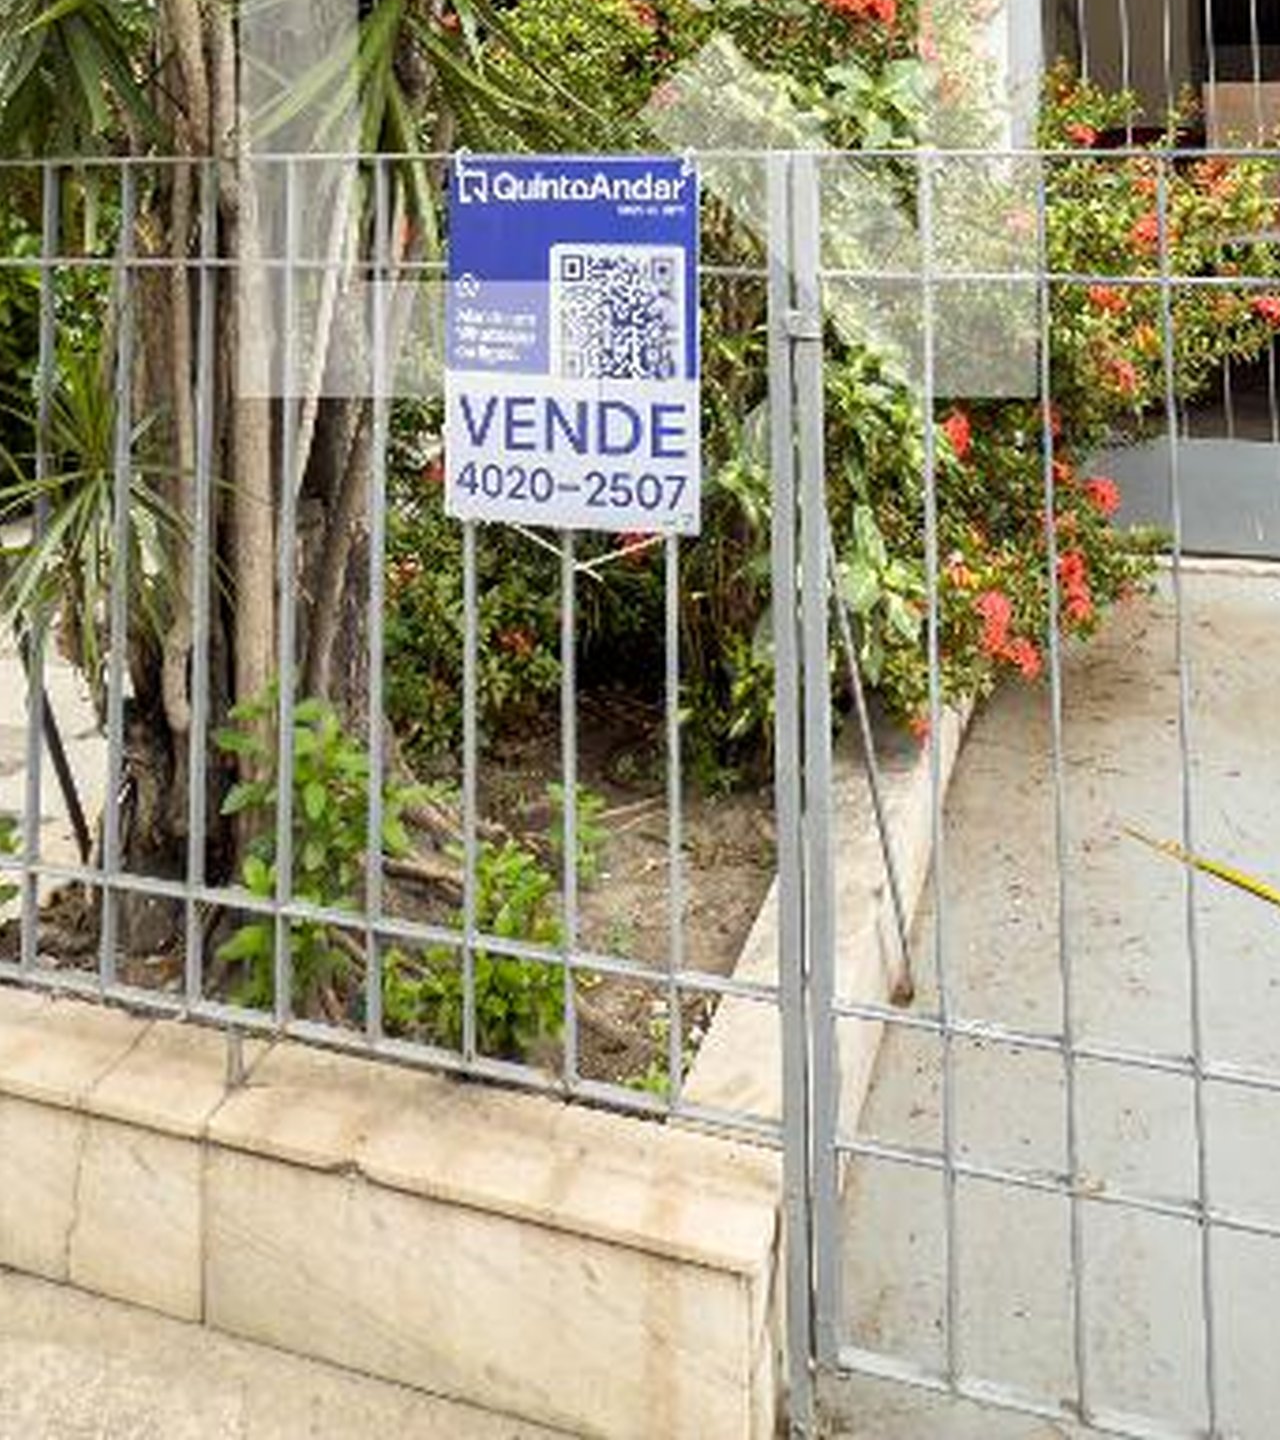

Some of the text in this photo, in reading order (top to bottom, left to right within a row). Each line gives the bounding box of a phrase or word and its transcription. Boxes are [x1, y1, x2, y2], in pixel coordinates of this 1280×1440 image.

[492, 171, 687, 202] QuintoAndar
[459, 394, 687, 458] VENDE
[456, 461, 688, 510] 4020-2507
